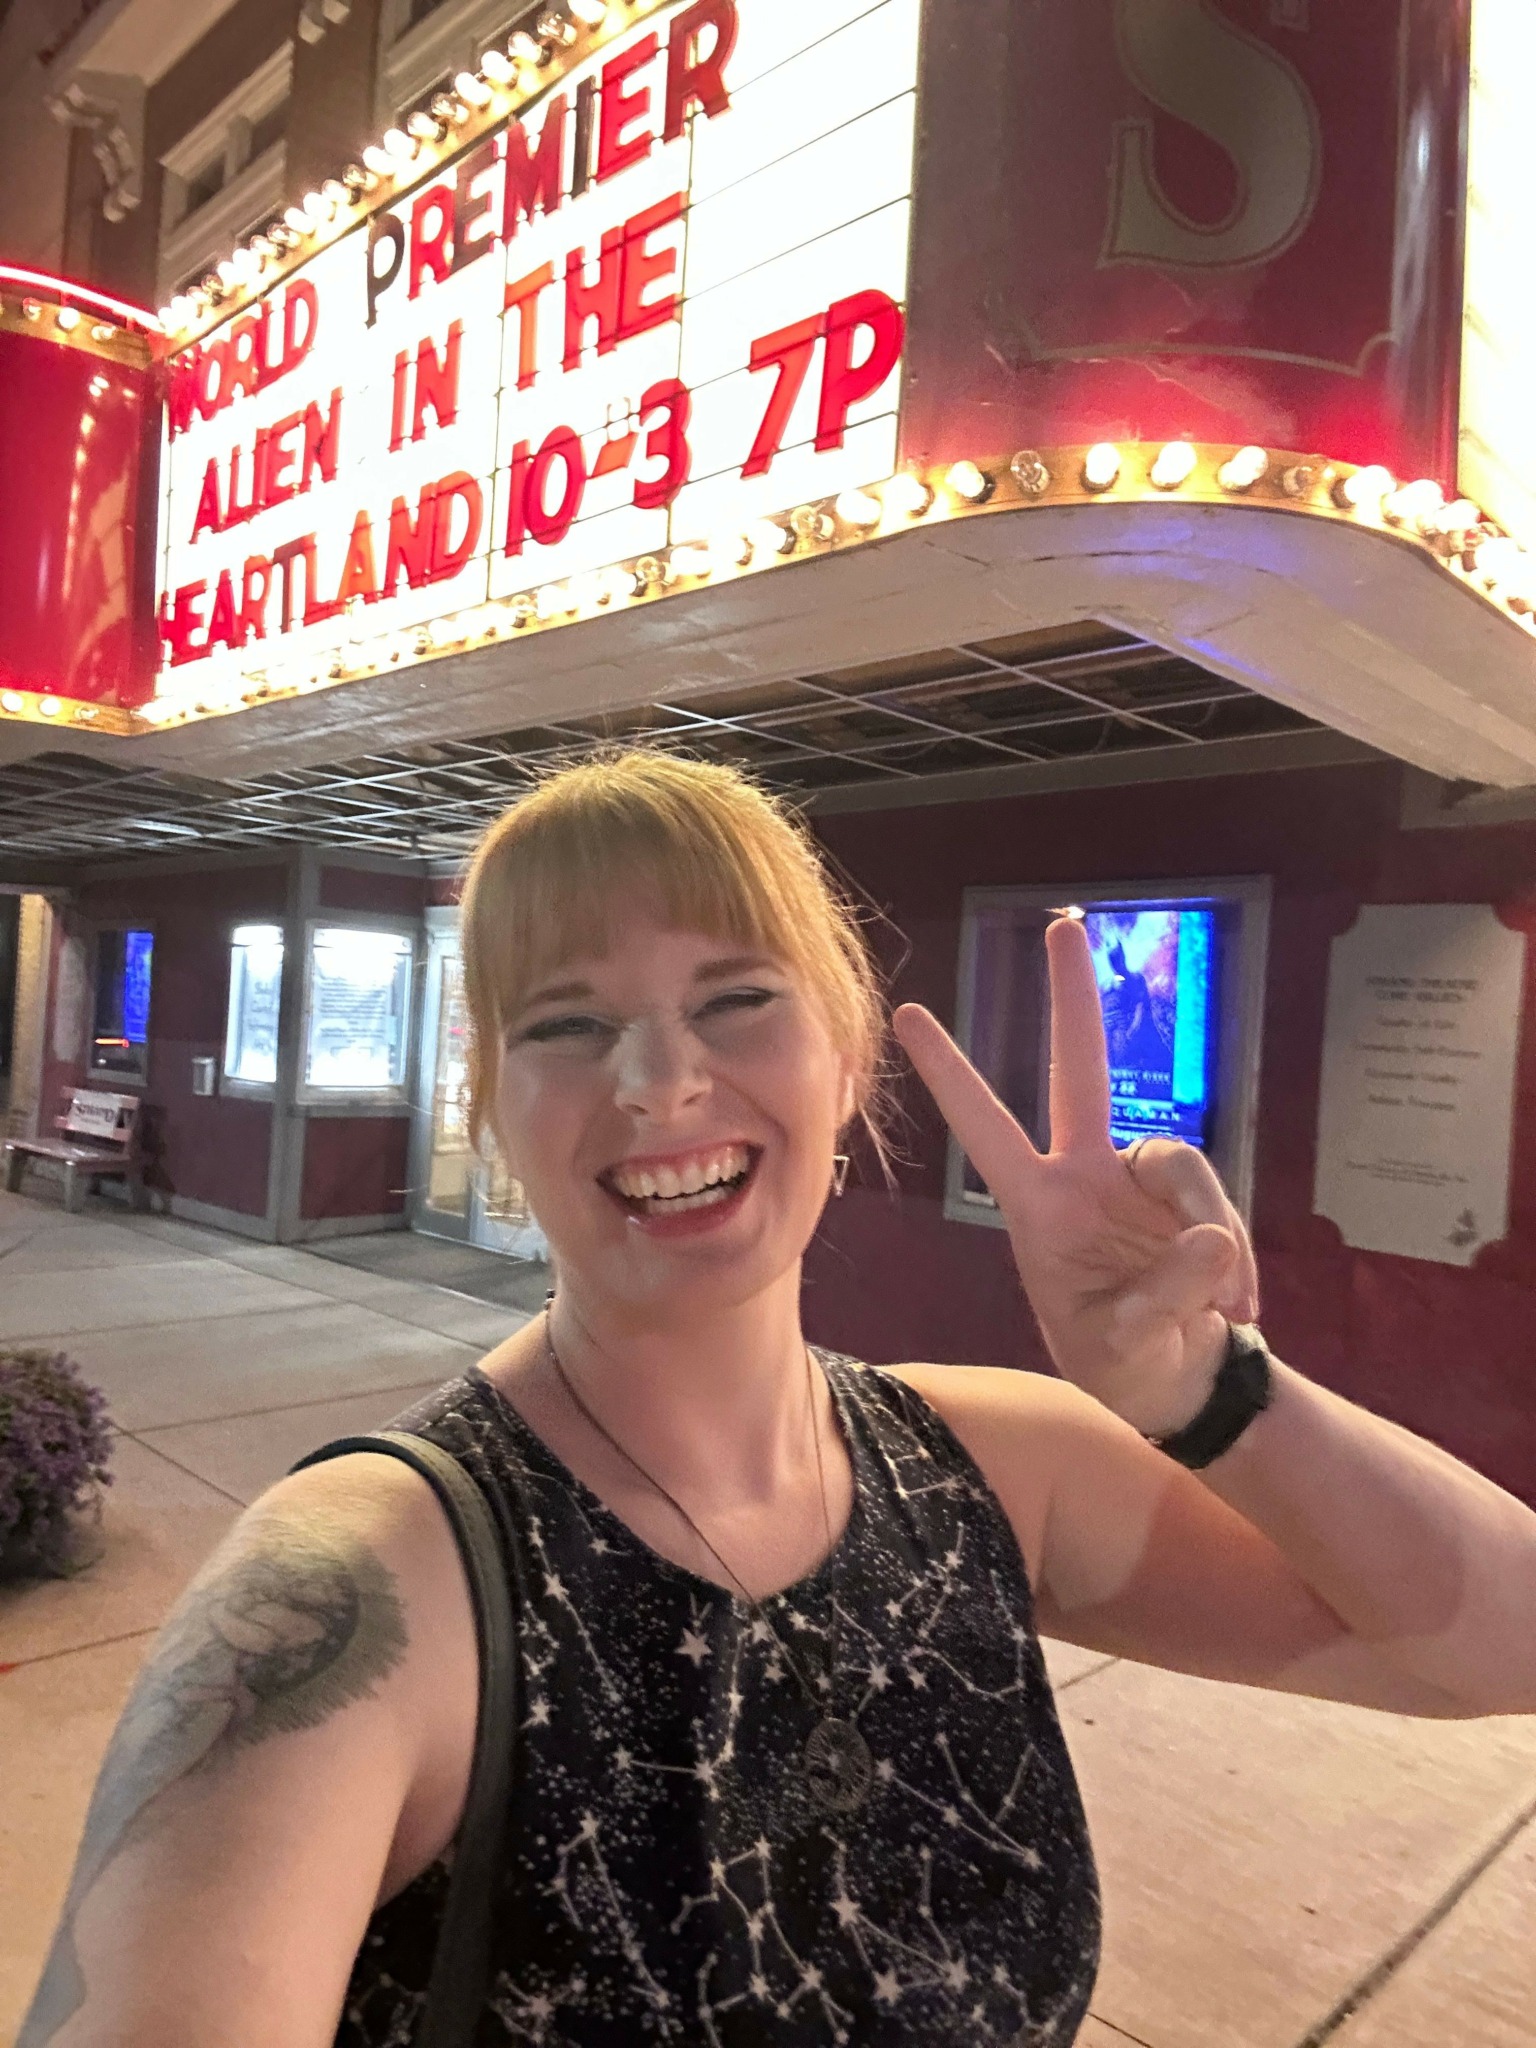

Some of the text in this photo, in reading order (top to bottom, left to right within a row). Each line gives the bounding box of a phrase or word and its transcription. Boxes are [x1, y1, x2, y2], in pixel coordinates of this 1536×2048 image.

[168, 0, 740, 445] WORLD PREMIER
[1097, 0, 1322, 271] S
[154, 288, 906, 668] HEARTLAND 10-3 7P
[188, 191, 688, 545] ALIEN IN THE
